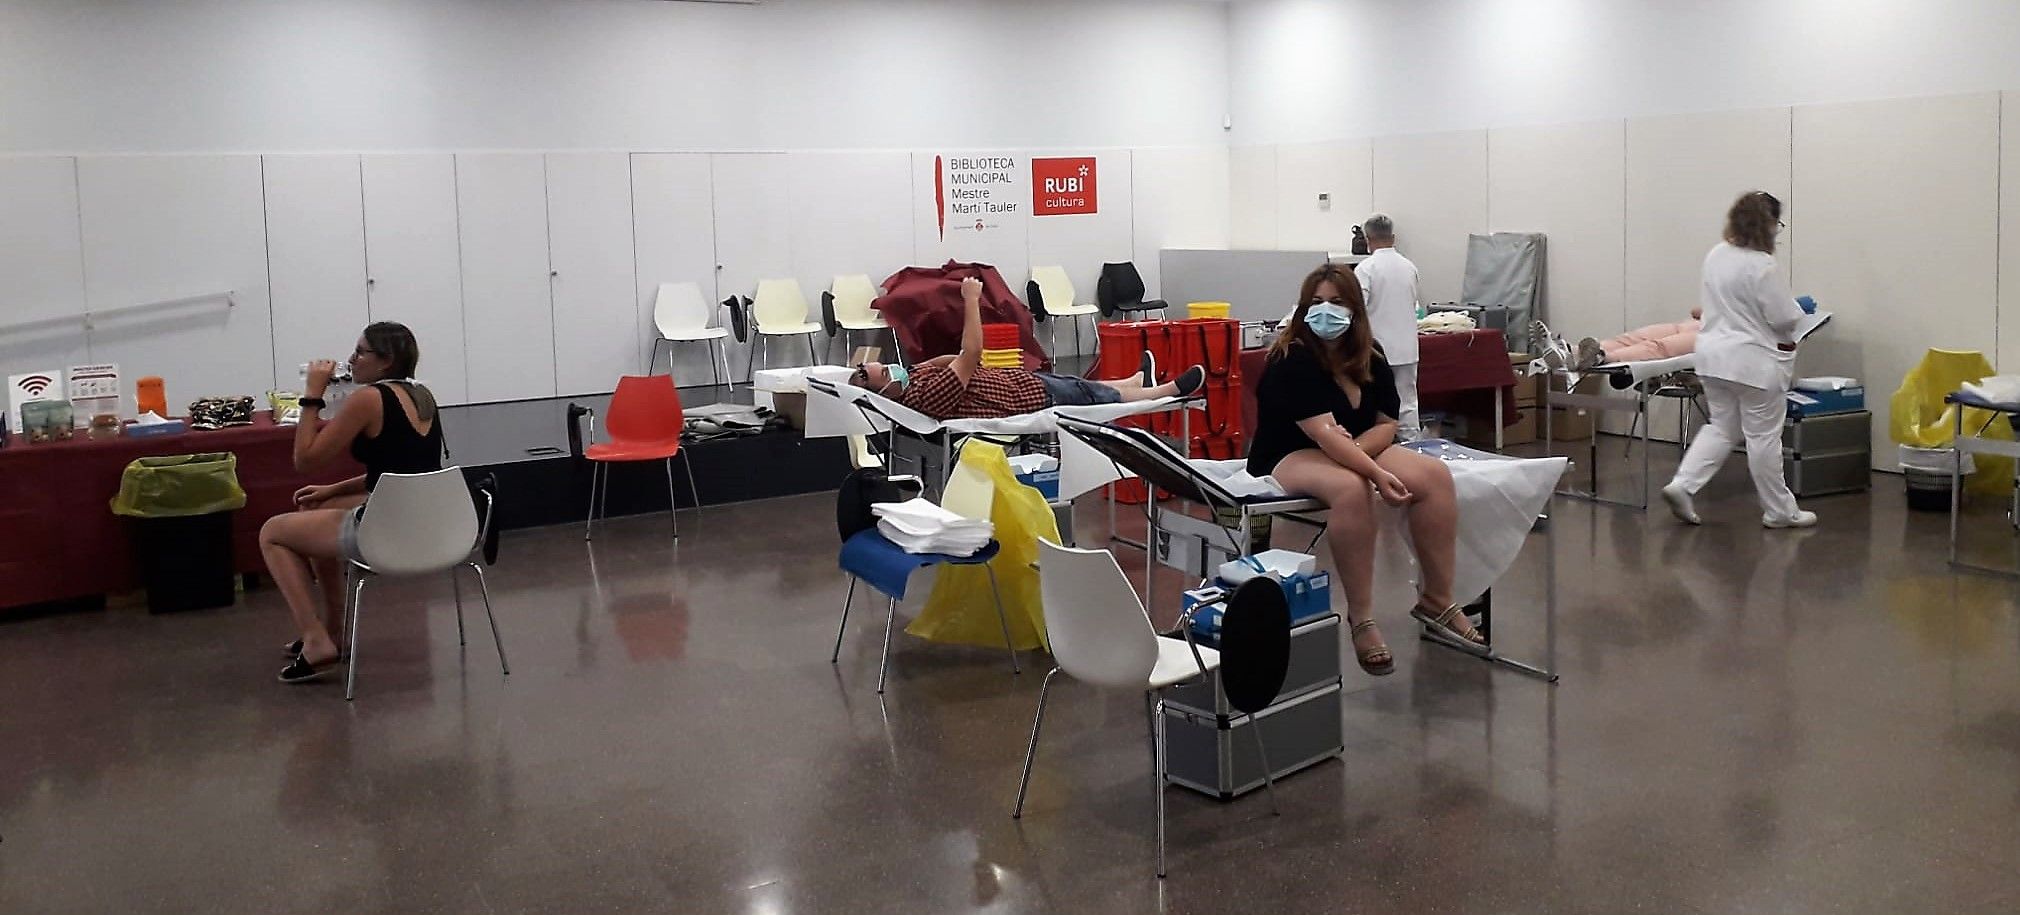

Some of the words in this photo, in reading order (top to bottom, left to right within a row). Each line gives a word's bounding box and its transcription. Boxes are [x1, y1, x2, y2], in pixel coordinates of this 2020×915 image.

[951, 158, 1015, 170] BIBLIOTECA
[951, 172, 1012, 185] MUNICIPAL
[951, 188, 990, 200] Mestre
[952, 201, 982, 214] Martí
[984, 201, 1017, 213] Tauler
[1046, 196, 1085, 208] cultura
